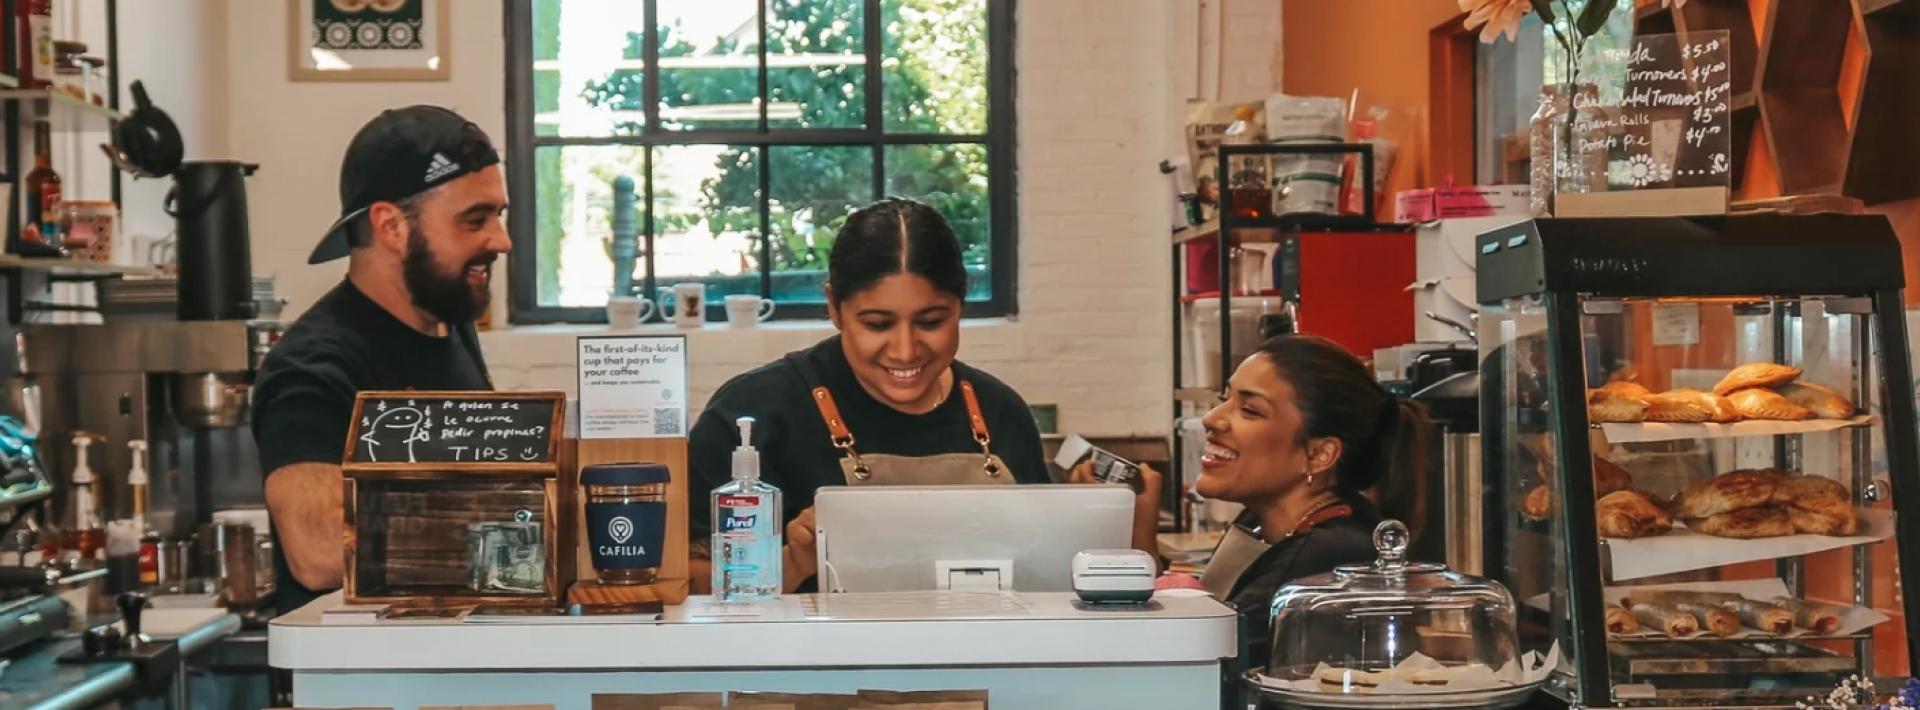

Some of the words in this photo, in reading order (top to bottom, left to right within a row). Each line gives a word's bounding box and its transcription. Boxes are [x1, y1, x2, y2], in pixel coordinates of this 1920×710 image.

[1625, 68, 1688, 82] Turnovers
[1691, 61, 1726, 84] $4.00
[1619, 115, 1650, 127] Rolls
[1686, 125, 1721, 148] $4.00
[424, 162, 460, 183] adidas
[583, 344, 601, 354] The
[603, 343, 679, 354] first-of-its-kind
[583, 358, 601, 367] cup
[603, 356, 624, 365] that
[626, 357, 650, 367] pays
[652, 354, 667, 364] for
[583, 369, 607, 379] your
[609, 366, 640, 376] coffee
[459, 401, 493, 412] quien
[501, 402, 519, 410] se
[448, 446, 509, 461] TIPS
[599, 545, 646, 556] CAFILIA
